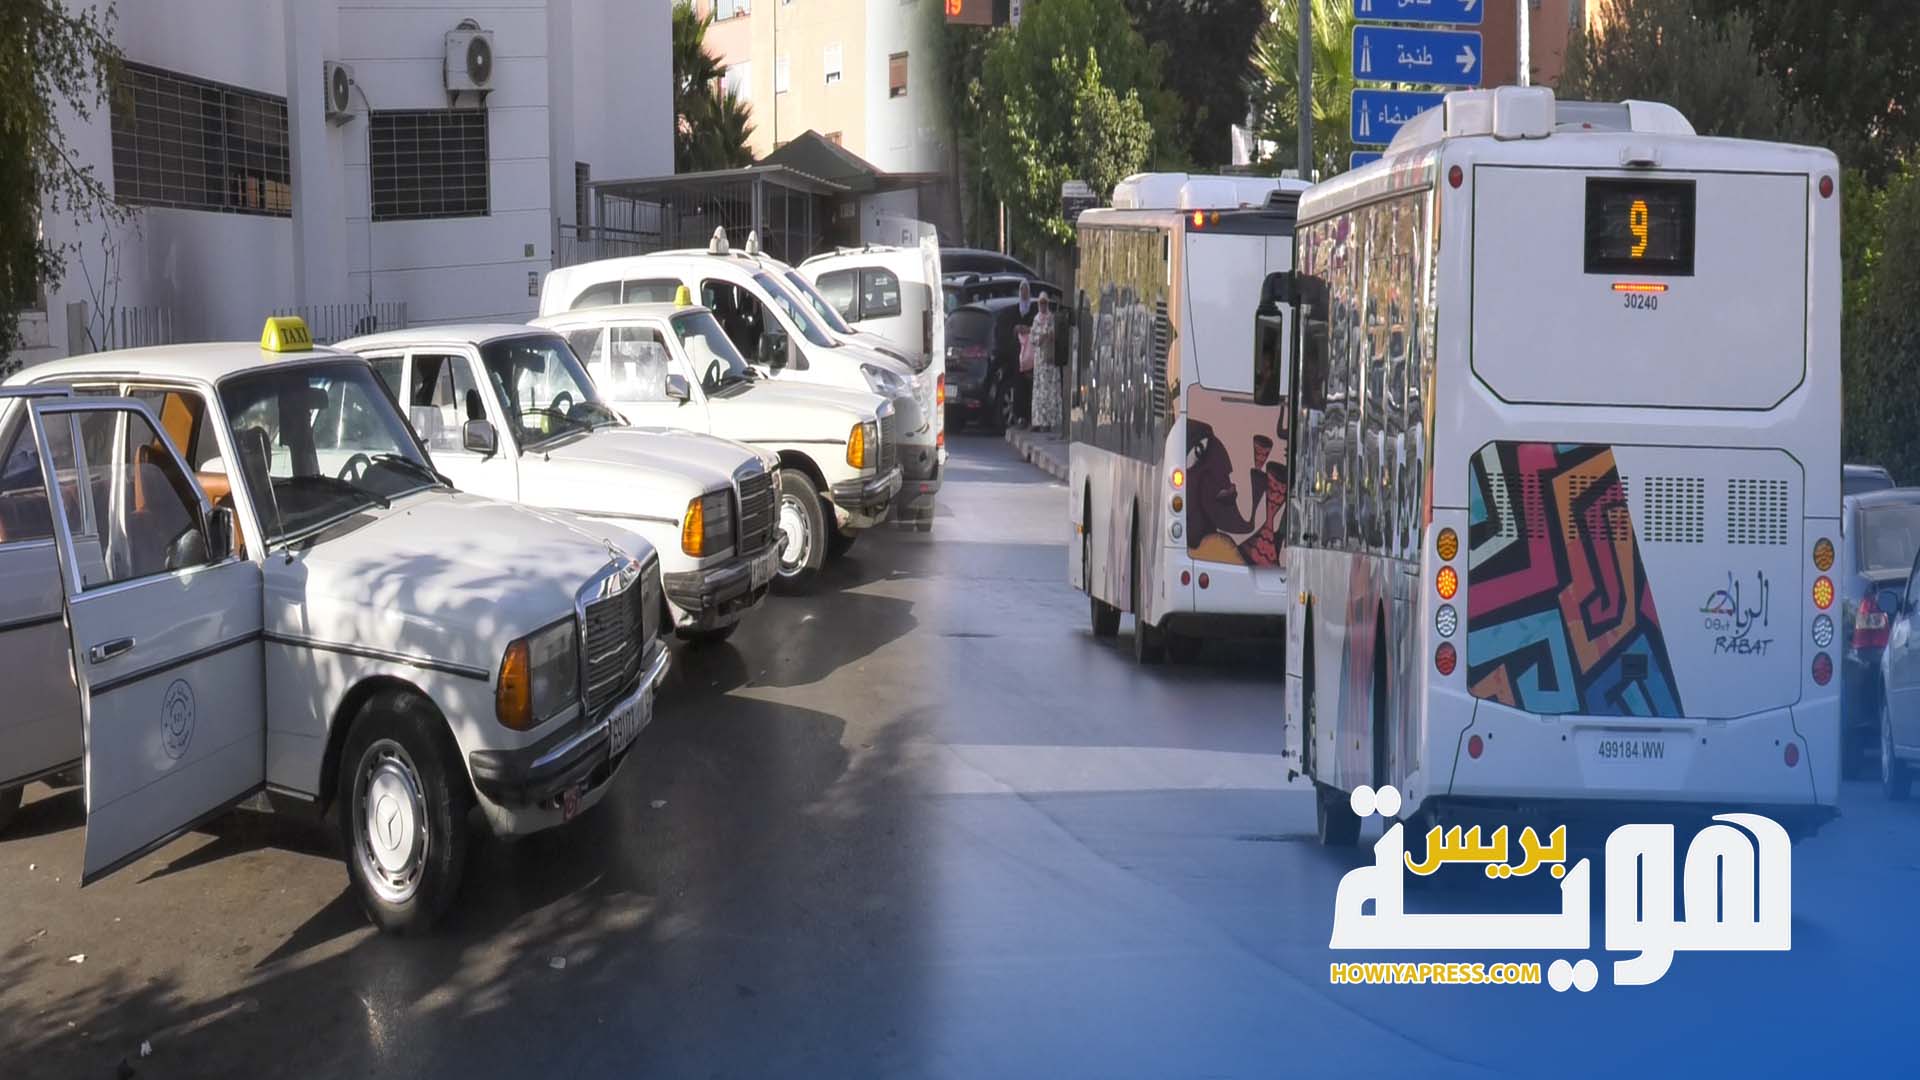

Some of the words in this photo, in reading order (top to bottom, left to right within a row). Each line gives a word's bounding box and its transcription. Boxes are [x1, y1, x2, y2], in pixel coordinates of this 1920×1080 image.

[1397, 44, 1433, 69] طنجة
[1630, 200, 1648, 257] 9
[1624, 293, 1658, 310] 30240
[280, 327, 308, 344] TAXI
[1713, 635, 1774, 656] RABAT
